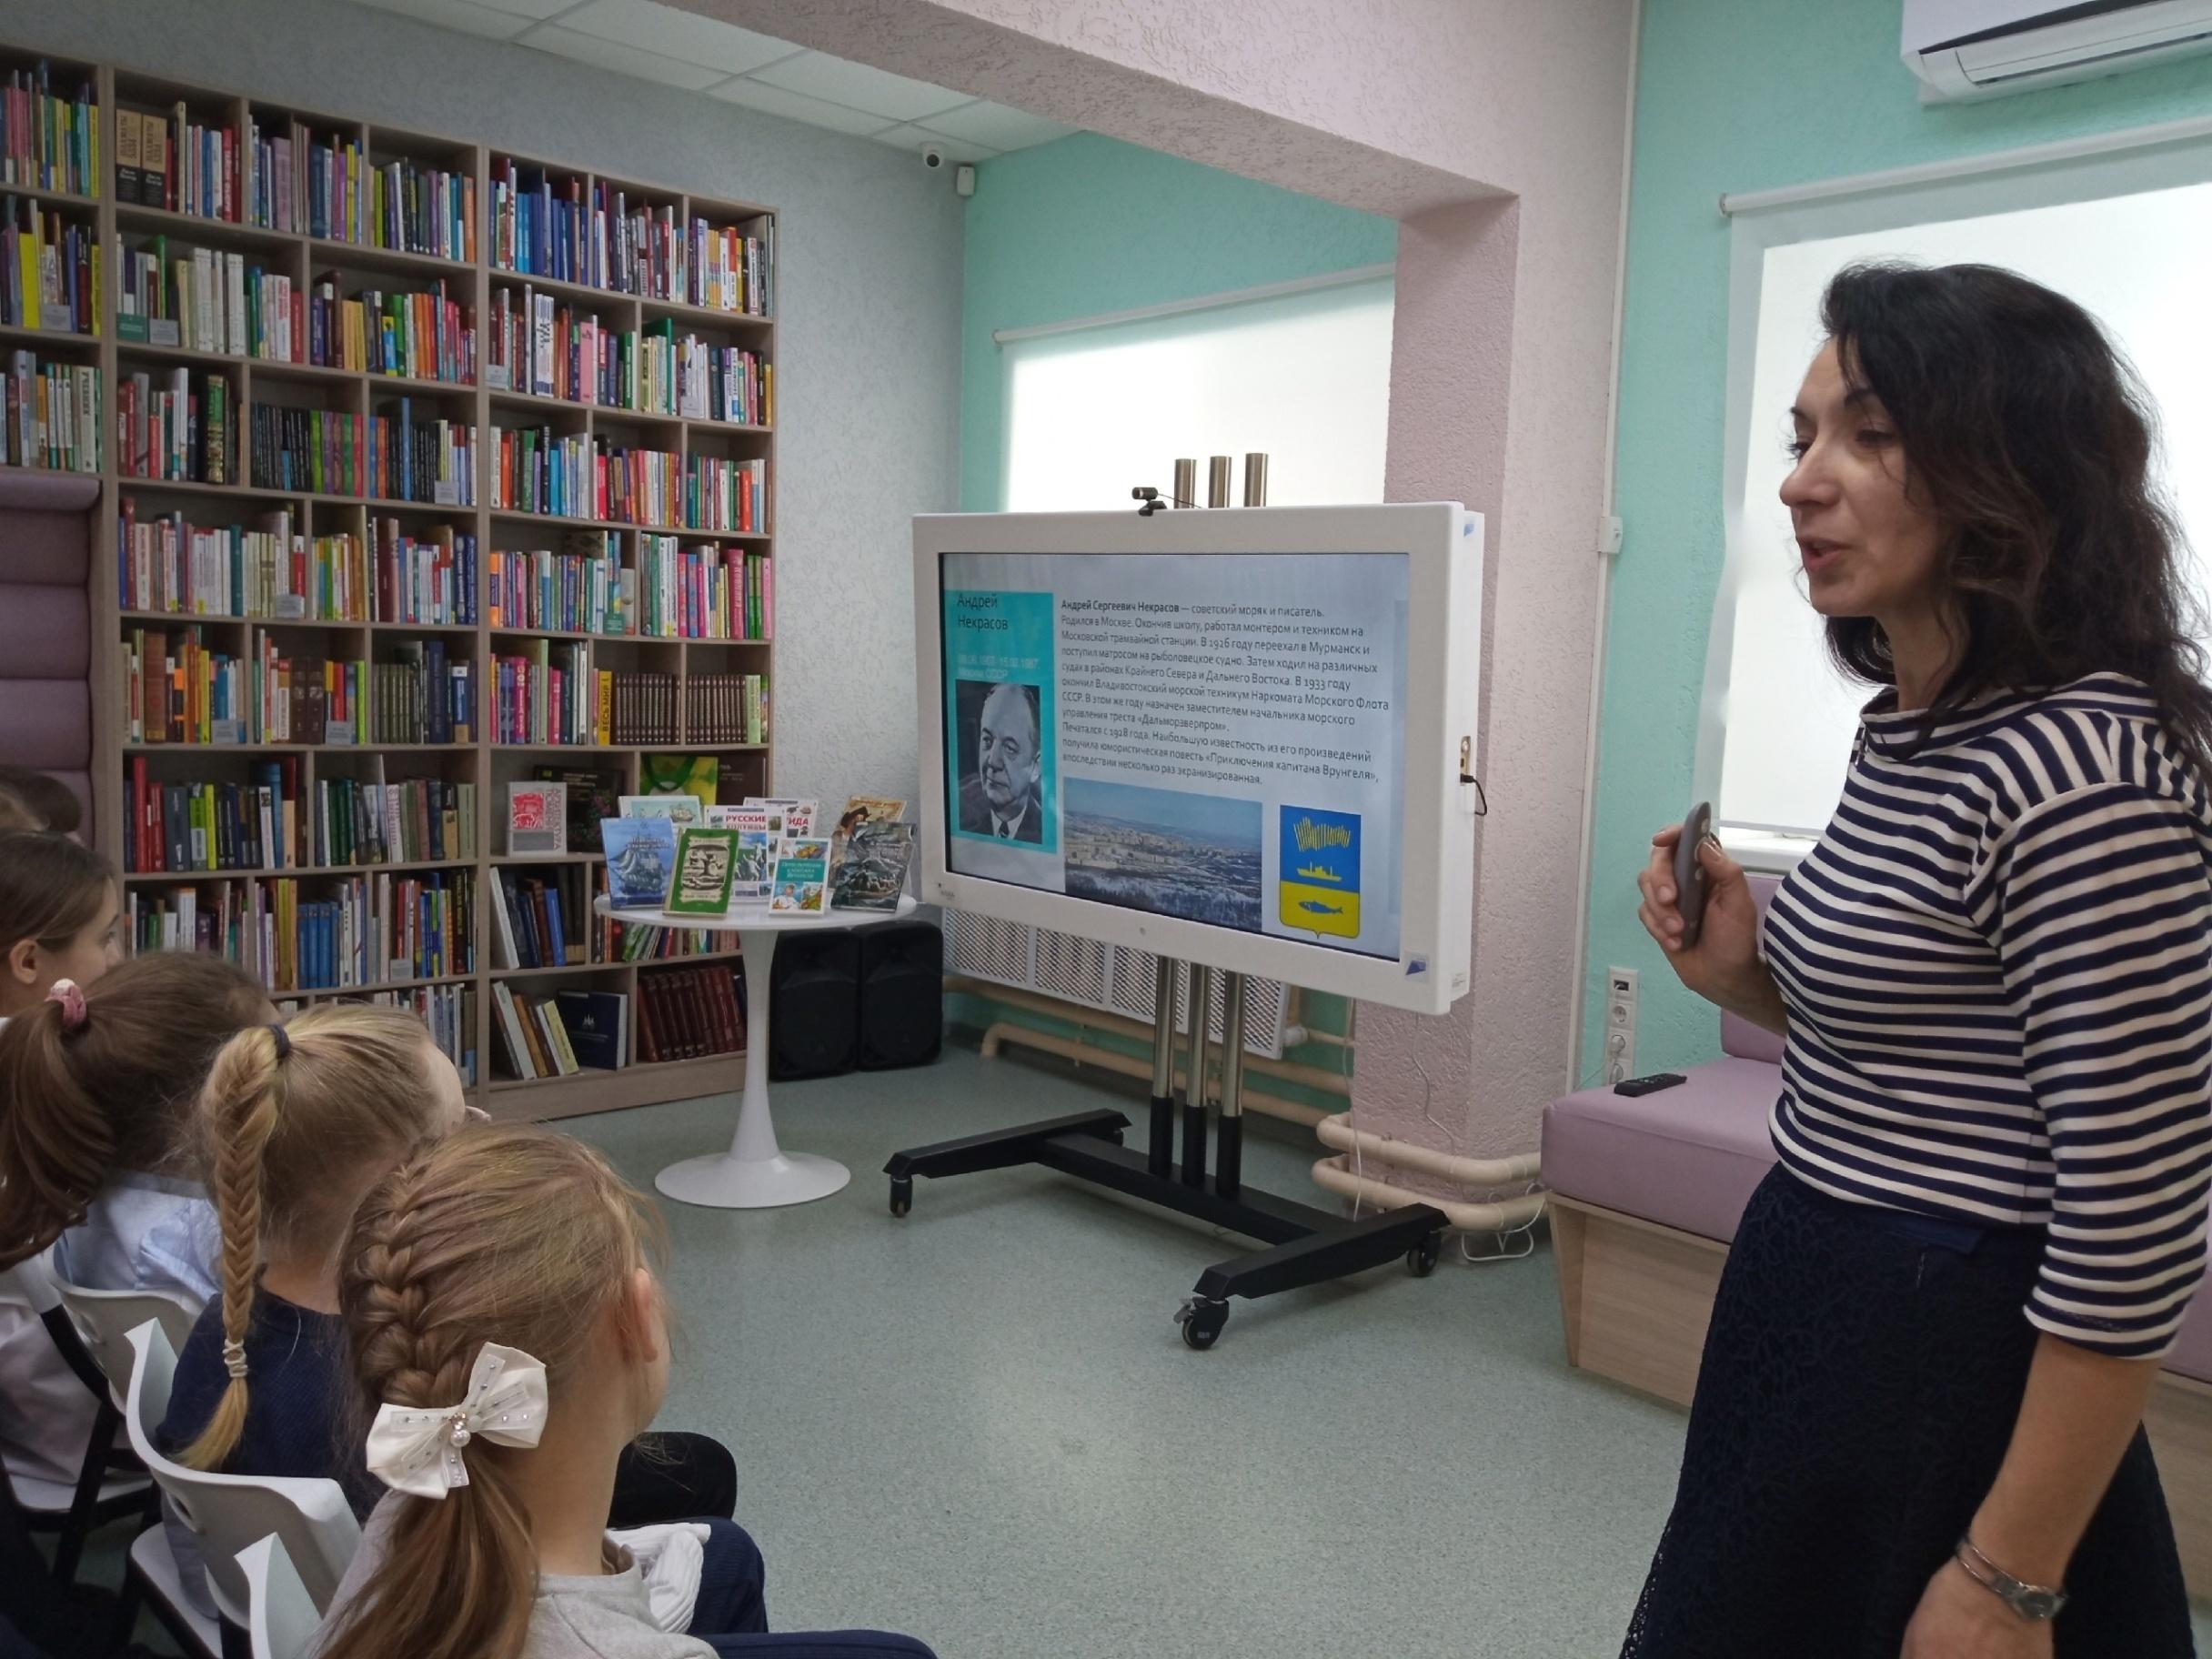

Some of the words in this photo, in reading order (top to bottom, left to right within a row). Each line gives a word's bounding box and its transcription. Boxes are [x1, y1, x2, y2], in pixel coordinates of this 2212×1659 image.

[958, 594, 998, 611] Андрей
[1061, 599, 1091, 612] Андрей
[1092, 600, 1136, 614] Сергеевич
[1138, 602, 1180, 614] Некрасов
[1191, 604, 1238, 615] советский
[1238, 607, 1269, 618] моряк
[1270, 608, 1276, 616] и
[1277, 608, 1325, 618] писатель.
[958, 617, 1009, 632] Некрасов
[1061, 615, 1093, 627] Родился
[1101, 617, 1133, 628] Москве.
[1134, 618, 1171, 629] Окончив
[1173, 620, 1202, 633] школу,
[1204, 620, 1242, 633] работал
[1292, 625, 1300, 634] и
[1302, 625, 1349, 637] техником
[1351, 628, 1364, 638] на
[1061, 630, 1109, 642] Московской
[1109, 634, 1160, 646] трамвайной
[1161, 637, 1199, 649] станции.
[1201, 637, 1207, 647] В
[1232, 641, 1252, 651] году
[1254, 641, 1300, 653] переехал
[1302, 644, 1307, 652] в
[1309, 642, 1362, 656] Мурманск
[1363, 646, 1370, 655] и
[1061, 648, 1098, 659] поступил
[1099, 650, 1138, 661] матросом
[1140, 652, 1150, 660] на
[1151, 652, 1214, 666] рыболовецкое
[1215, 657, 1244, 668] судно.
[1246, 655, 1274, 668] Затем
[1276, 659, 1306, 670] ходил
[1307, 660, 1320, 670] на
[1322, 661, 1378, 675] различных
[1091, 662, 1123, 676] районах
[1124, 665, 1165, 679] Крайнего
[1166, 668, 1197, 680] Севера
[1198, 671, 1204, 679] и
[1205, 670, 1251, 683] Дальнего
[1252, 673, 1292, 686] Востока.
[1294, 676, 1302, 686] В
[1304, 679, 1325, 691] 1933
[1327, 680, 1351, 692] году
[1095, 679, 1168, 694] Владивостокский
[1168, 685, 1206, 698] морской
[1206, 689, 1250, 700] техникум
[1251, 692, 1303, 706] Наркомата
[1304, 694, 1355, 709] Морского
[1356, 697, 1390, 711] Флота
[1061, 691, 1083, 703] СССР.
[1085, 693, 1091, 703] В
[1092, 697, 1112, 706] этом
[1112, 699, 1124, 707] же
[1125, 699, 1144, 710] году
[1145, 700, 1185, 712] назначен
[1186, 704, 1249, 718] заместителем
[1250, 709, 1307, 722] начальника
[1307, 713, 1356, 727] морского
[1109, 712, 1136, 723] треста
[1100, 741, 1169, 759] юмористическая
[1170, 749, 1204, 762] повесть
[1205, 751, 1274, 769] «Приключения
[1275, 761, 1321, 775] капитана
[1152, 730, 1209, 747] Наибольшую
[1210, 739, 1266, 753] известность
[1267, 745, 1279, 754] из
[1280, 746, 1296, 757] его
[1297, 747, 1372, 763] произведений
[1062, 753, 1117, 768] впоследствии
[1118, 760, 1160, 773] несколько
[1161, 764, 1176, 774] раз
[1177, 767, 1262, 785] экранизированная.
[725, 814, 767, 823] РУССКИЕ
